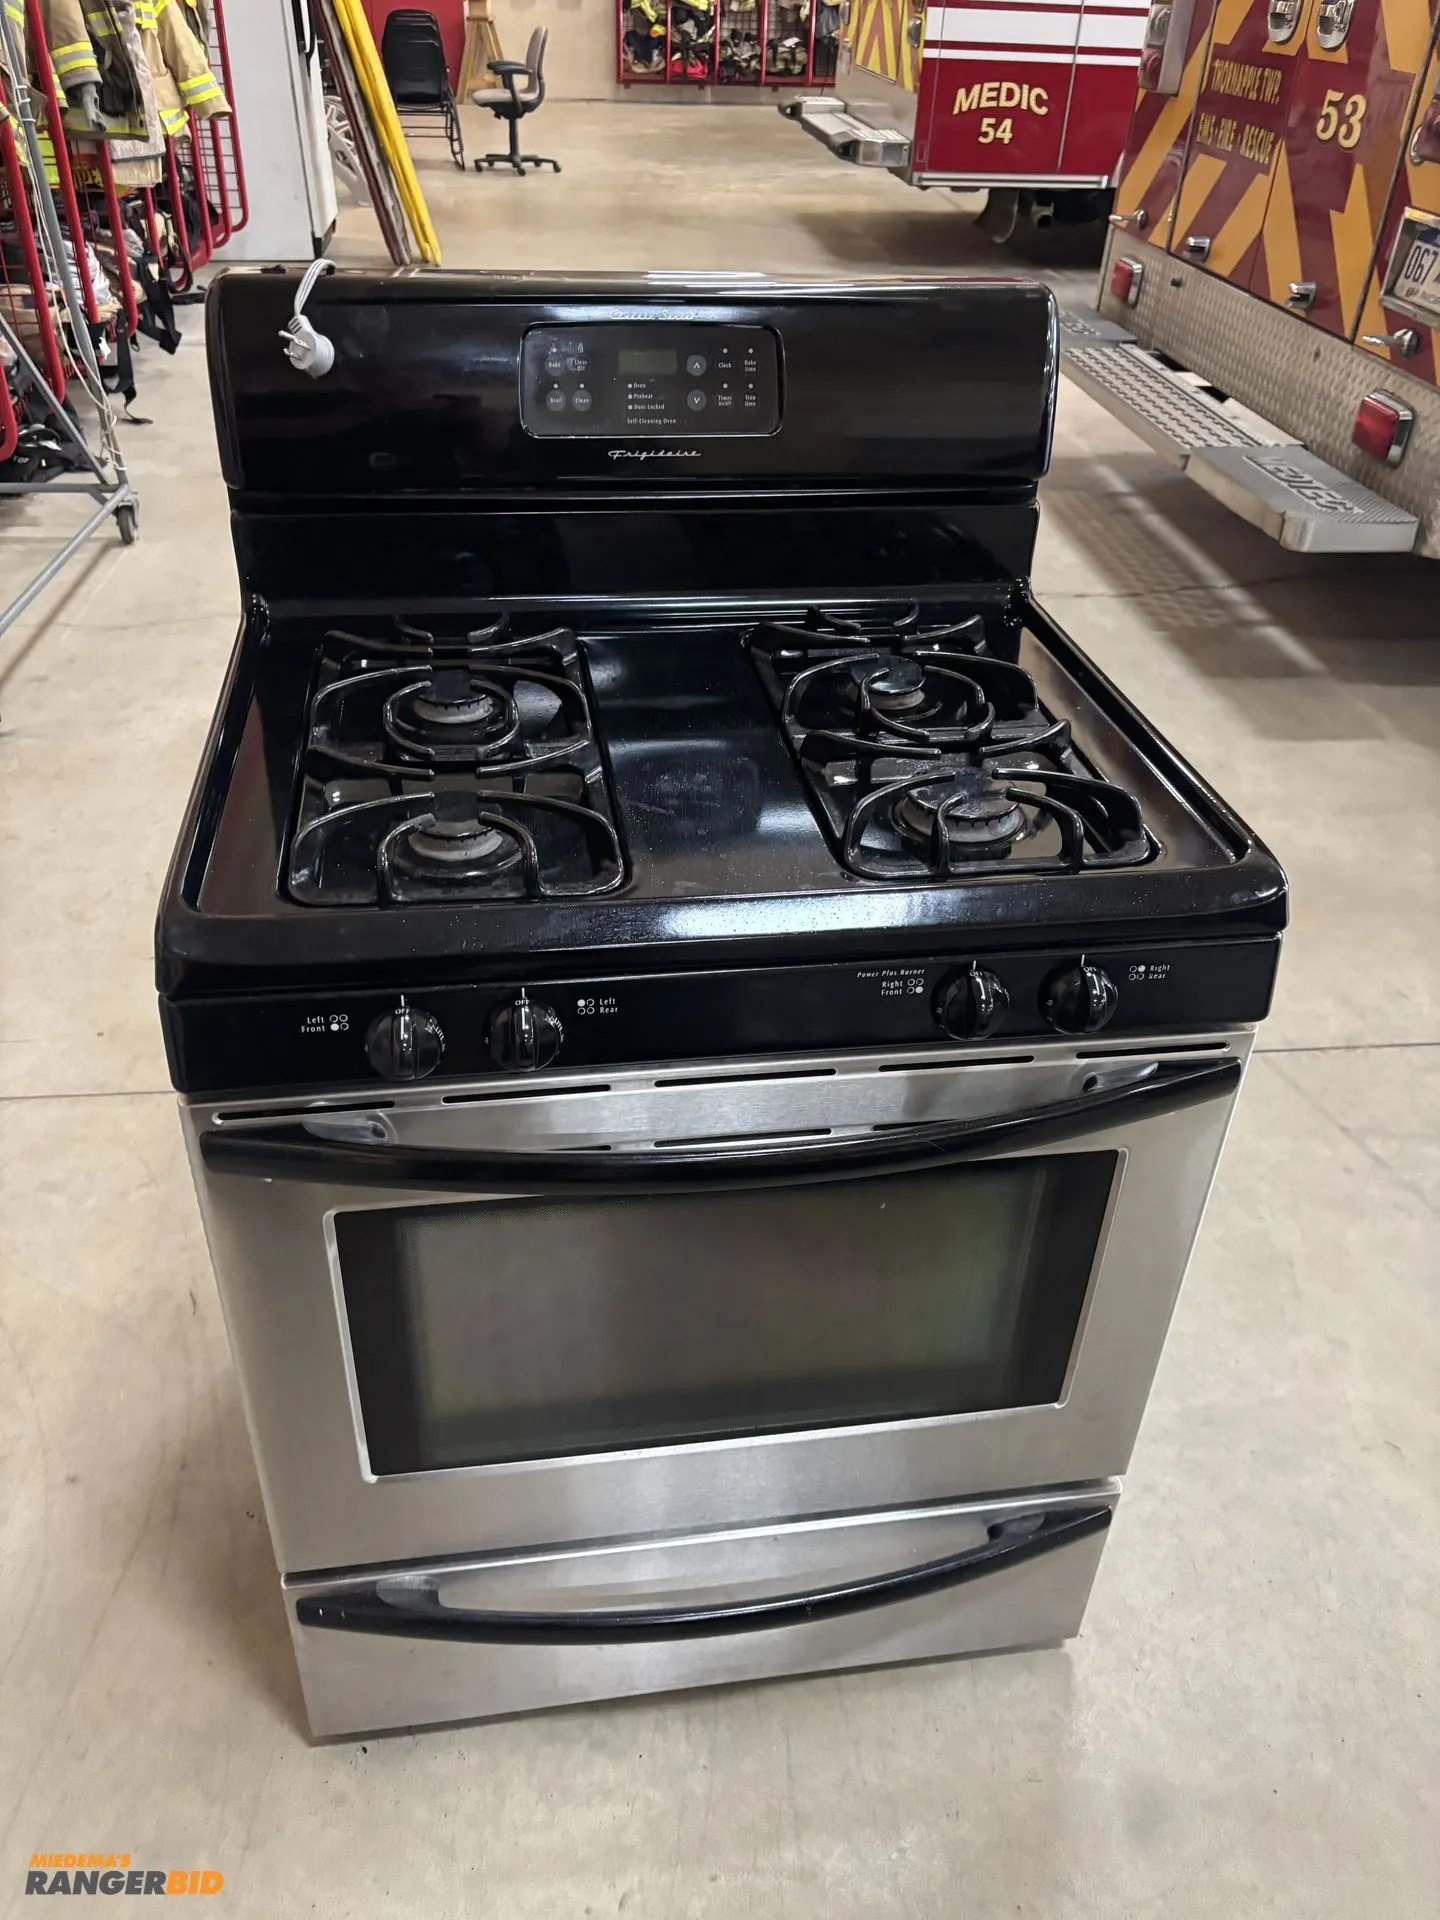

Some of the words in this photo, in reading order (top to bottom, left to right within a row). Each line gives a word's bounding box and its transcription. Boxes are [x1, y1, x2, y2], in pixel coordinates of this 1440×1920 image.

[953, 82, 1049, 115] MEDIC
[1316, 89, 1366, 148] 53
[978, 117, 1013, 144] 54
[1217, 118, 1237, 152] FIRE
[1240, 124, 1275, 164] RESCUE
[718, 361, 732, 369] Clock
[662, 417, 677, 425] Oven
[608, 449, 701, 461] Frigidaire
[856, 971, 879, 979] Power
[881, 969, 898, 977] Plus
[899, 967, 925, 977] Burner
[1150, 964, 1171, 973] Right
[1148, 972, 1167, 980] Rear
[881, 980, 903, 989] Right
[880, 988, 903, 997] Front
[514, 999, 531, 1007] OFF
[599, 997, 616, 1006] Left
[394, 1008, 410, 1016] OFF
[599, 1005, 618, 1014] Rear
[306, 1015, 325, 1025] Left
[300, 1025, 326, 1034] Front
